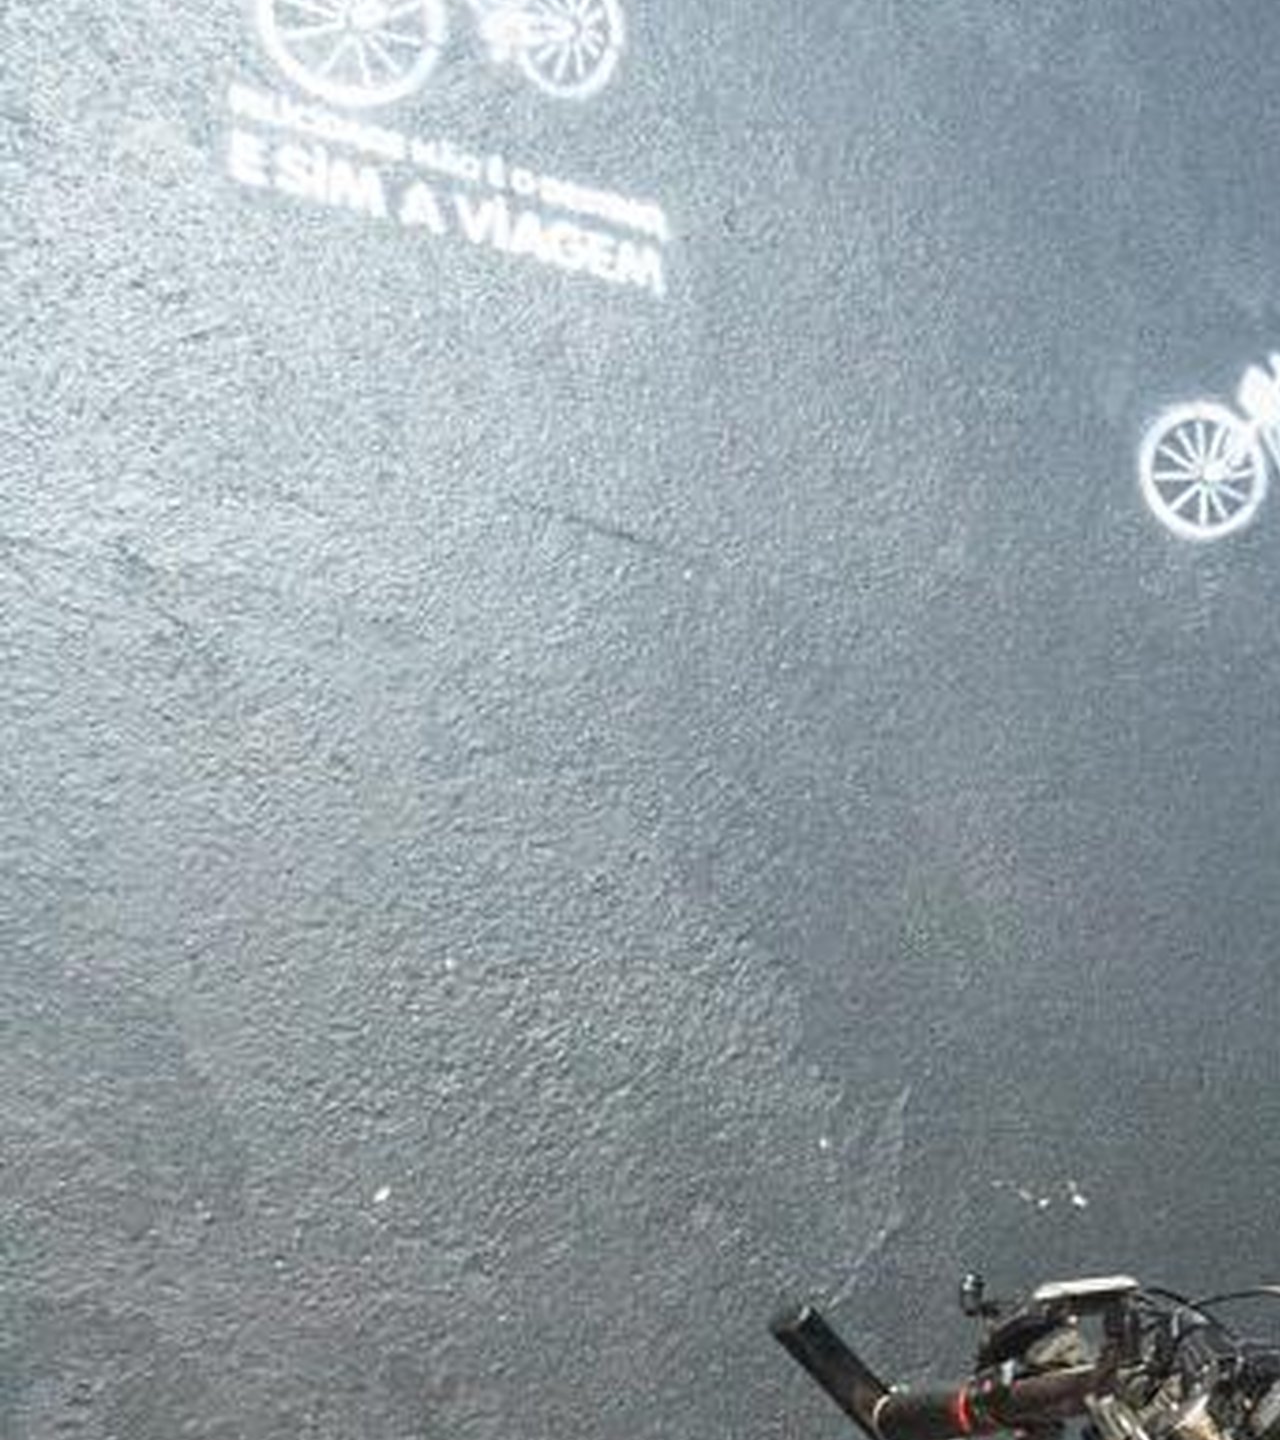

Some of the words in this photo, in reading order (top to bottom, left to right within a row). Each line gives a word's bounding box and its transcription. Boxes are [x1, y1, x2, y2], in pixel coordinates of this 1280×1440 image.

[228, 127, 271, 187] E
[274, 143, 388, 220] SIM
[398, 179, 448, 236] A
[452, 192, 668, 298] VIAGEM
